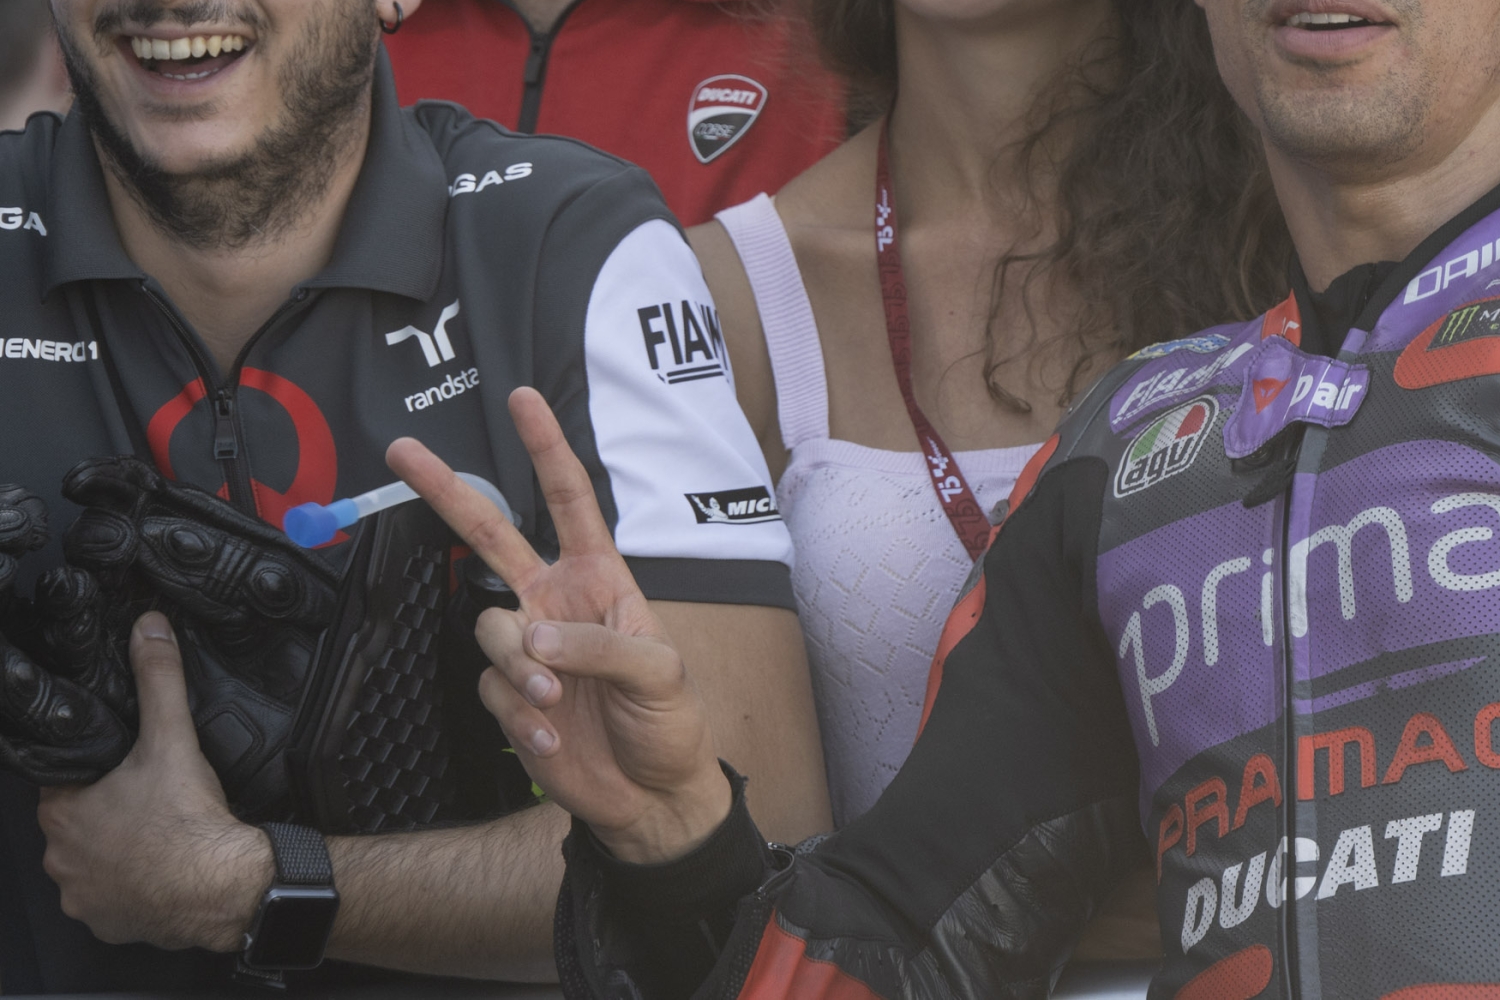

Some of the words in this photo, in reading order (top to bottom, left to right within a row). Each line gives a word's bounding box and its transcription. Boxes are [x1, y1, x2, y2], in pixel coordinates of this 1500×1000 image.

[697, 87, 758, 106] DUCATI
[452, 162, 533, 198] GAS
[1182, 808, 1476, 955] DUCATI
